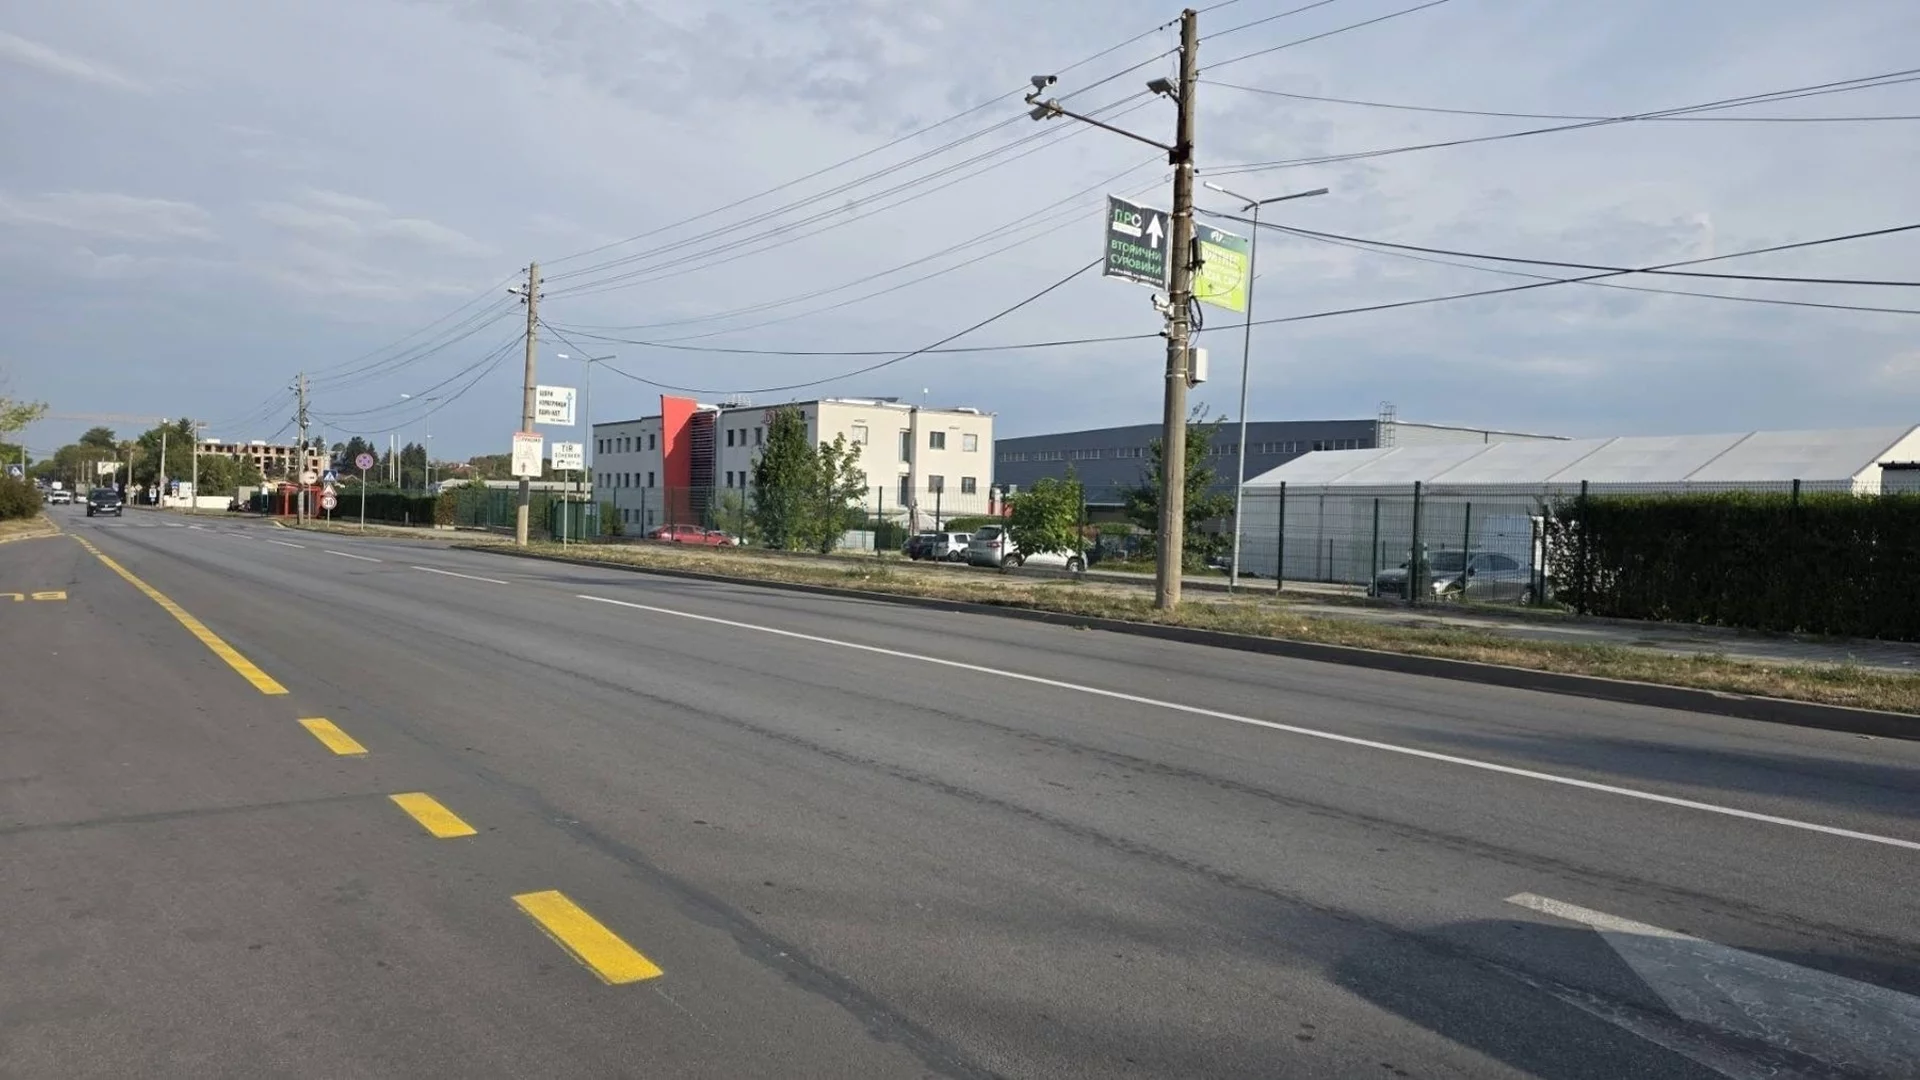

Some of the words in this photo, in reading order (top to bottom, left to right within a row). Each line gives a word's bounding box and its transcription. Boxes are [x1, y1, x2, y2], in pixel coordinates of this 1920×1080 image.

[1112, 240, 1162, 261] ВТОРИЧНИ
[1111, 254, 1161, 274] СУРОВИНИ
[562, 444, 573, 452] TIR
